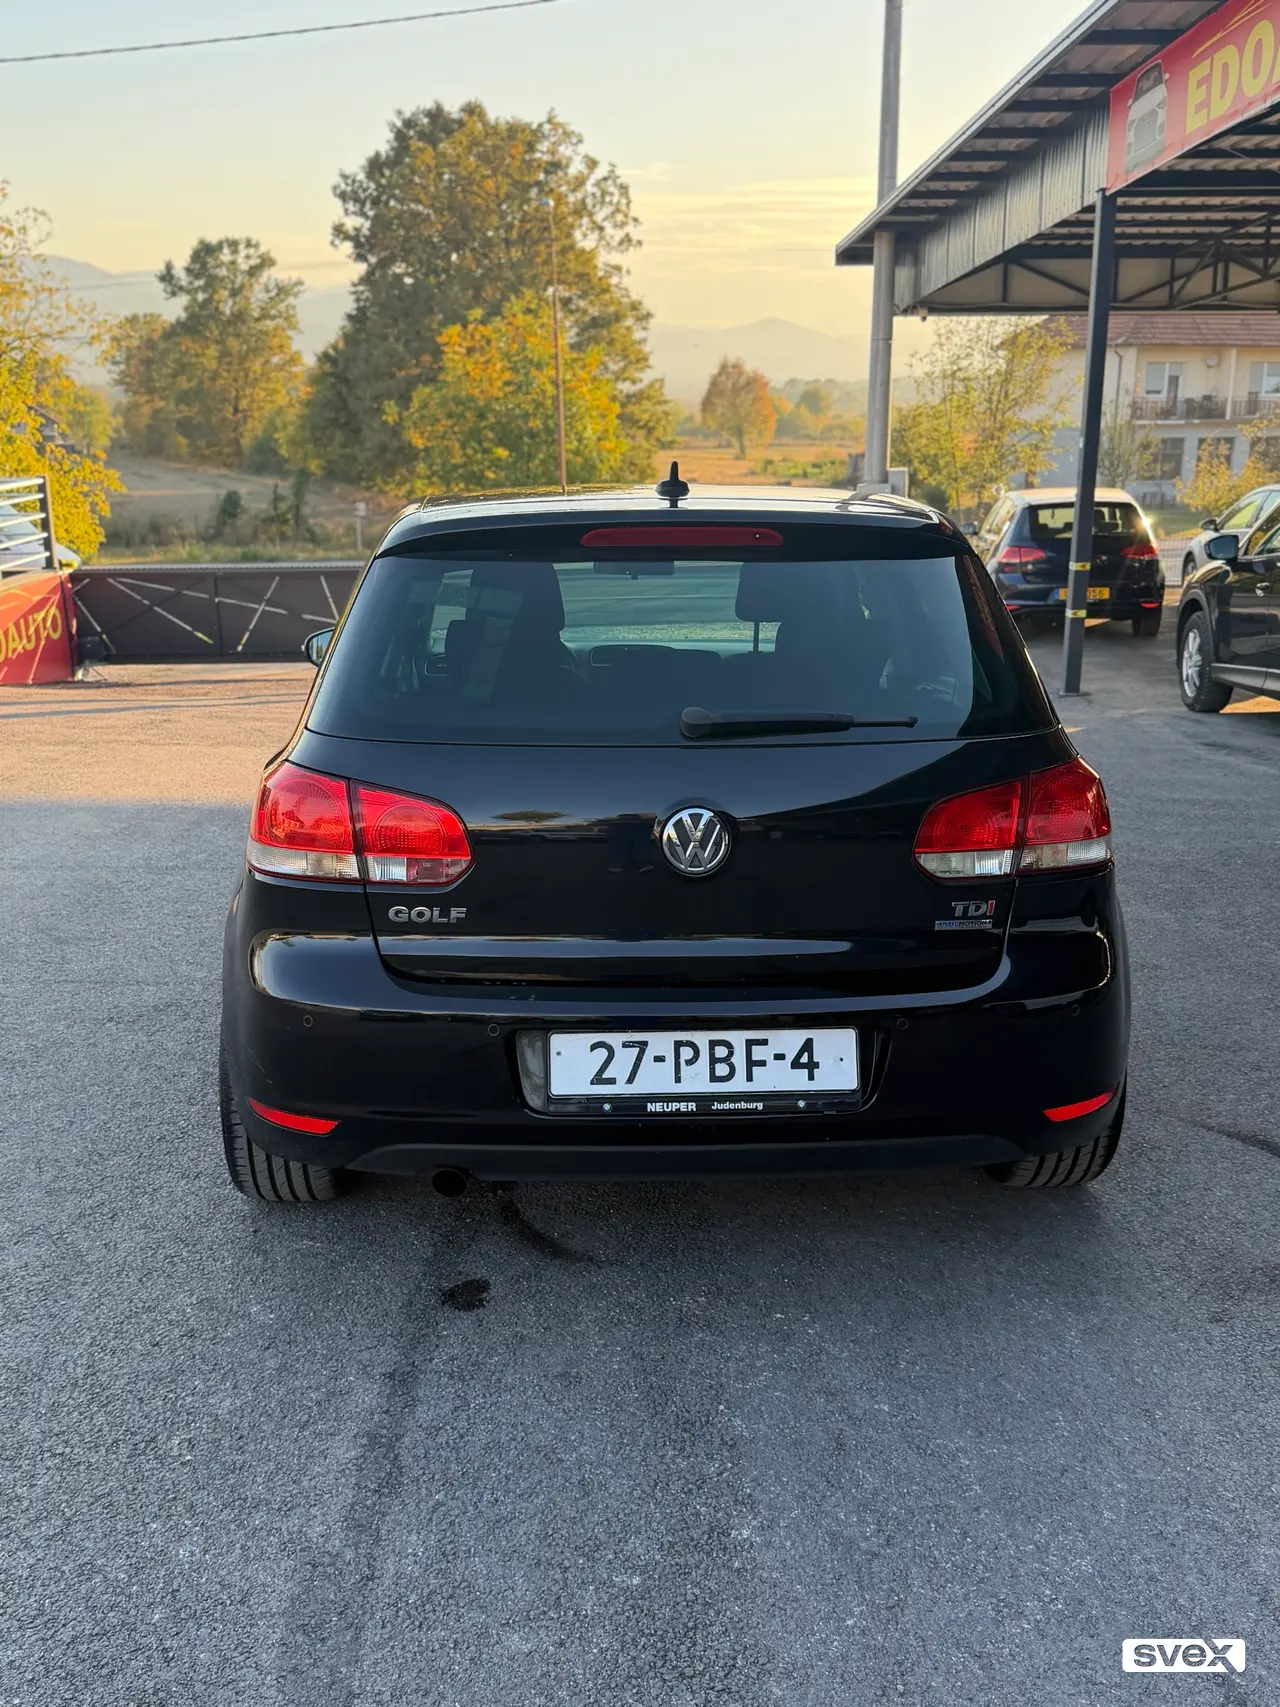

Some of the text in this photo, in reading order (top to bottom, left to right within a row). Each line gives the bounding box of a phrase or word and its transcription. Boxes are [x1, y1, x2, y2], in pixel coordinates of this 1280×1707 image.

[1186, 19, 1280, 135] EDO
[388, 905, 467, 923] GOLF
[952, 900, 996, 917] TDI
[589, 1037, 820, 1086] 27-PBF-4
[646, 1101, 763, 1112] NEUPER Judenburg
